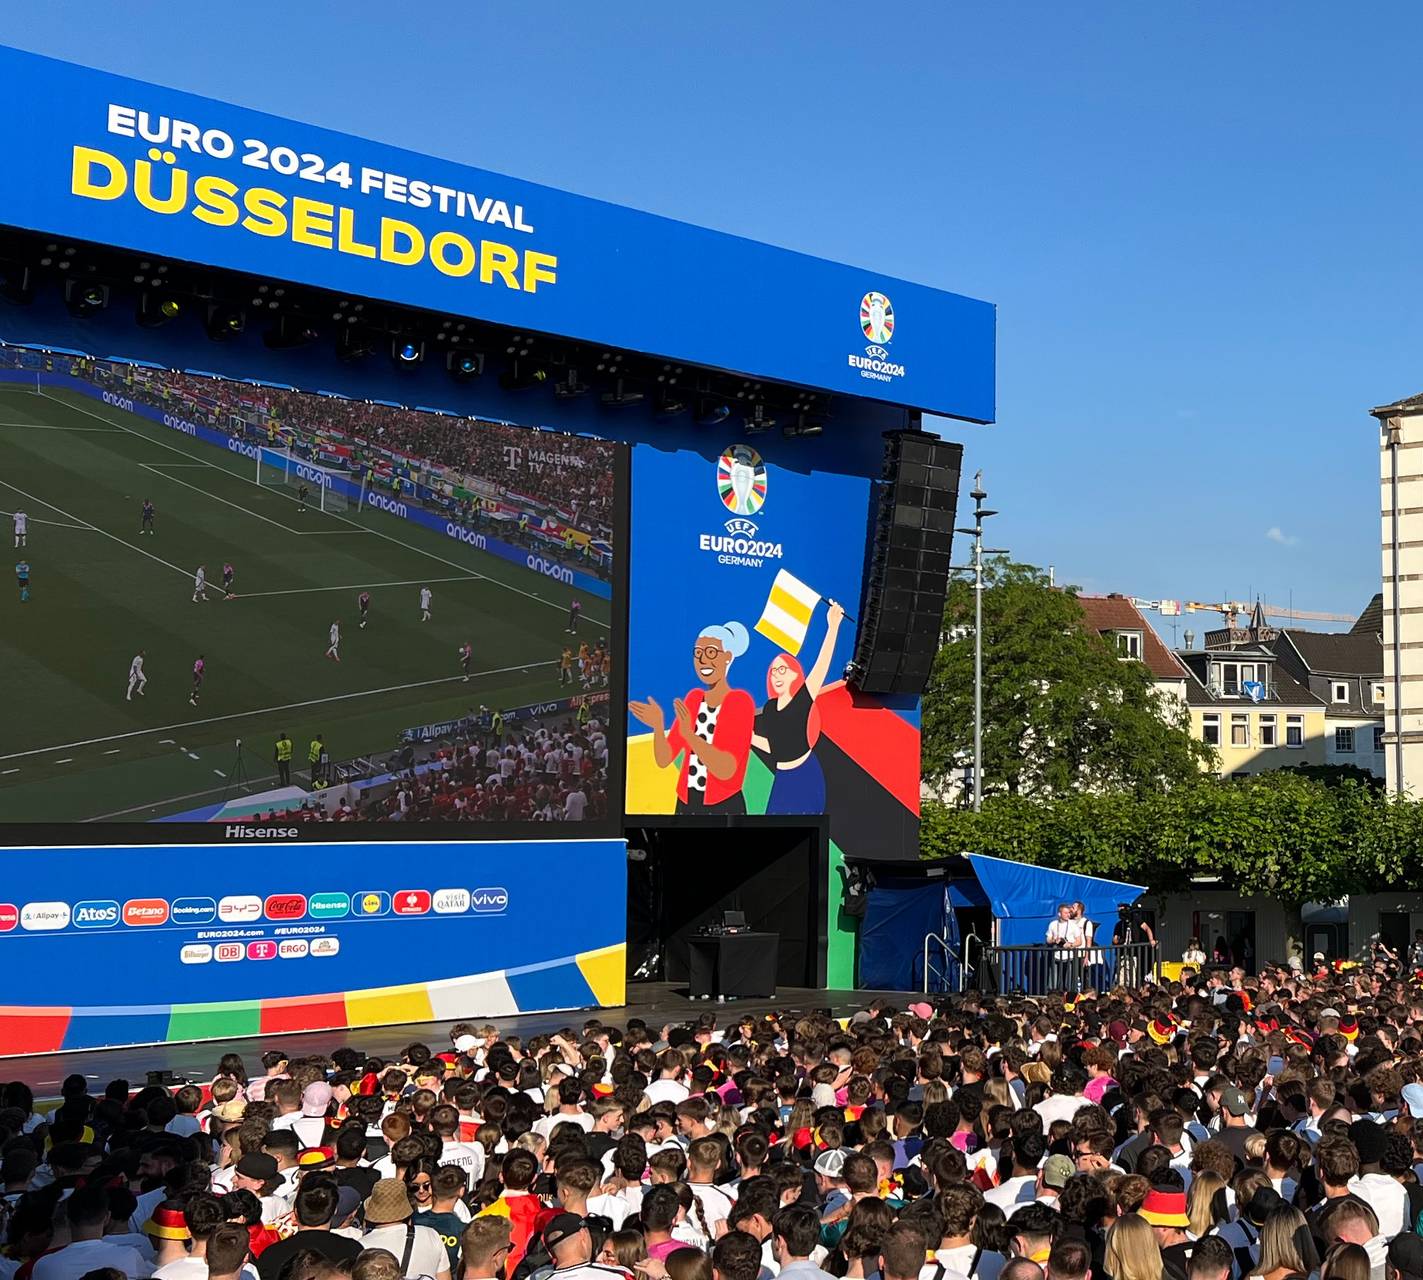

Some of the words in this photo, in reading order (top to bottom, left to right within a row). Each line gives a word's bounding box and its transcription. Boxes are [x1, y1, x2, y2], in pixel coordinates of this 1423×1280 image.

[107, 103, 234, 160] EURO
[242, 139, 352, 189] 2024
[360, 166, 534, 233] FESTIVAL
[71, 145, 558, 294] DÜSSELDORF
[848, 354, 905, 378] EURO2024
[861, 370, 892, 382] GERMANY
[103, 391, 133, 412] antom
[163, 414, 196, 436] antom
[296, 464, 332, 489] antom
[368, 492, 407, 519] antom
[446, 523, 487, 549] antom
[726, 520, 757, 538] UEFA
[699, 534, 784, 559] EURO2024
[718, 554, 764, 568] GERMANY
[527, 555, 574, 585] antom
[529, 703, 557, 716] vivo
[225, 825, 298, 838] Hisense
[311, 902, 347, 910] Hisense
[437, 900, 465, 909] QATAR
[473, 893, 506, 905] vivo
[128, 907, 164, 916] Betano
[173, 907, 214, 915] Booking.com
[221, 904, 260, 914] BYD
[197, 929, 264, 939] EURO2024.com
[274, 926, 325, 935] #EURO2024
[280, 944, 306, 953] ERGO
